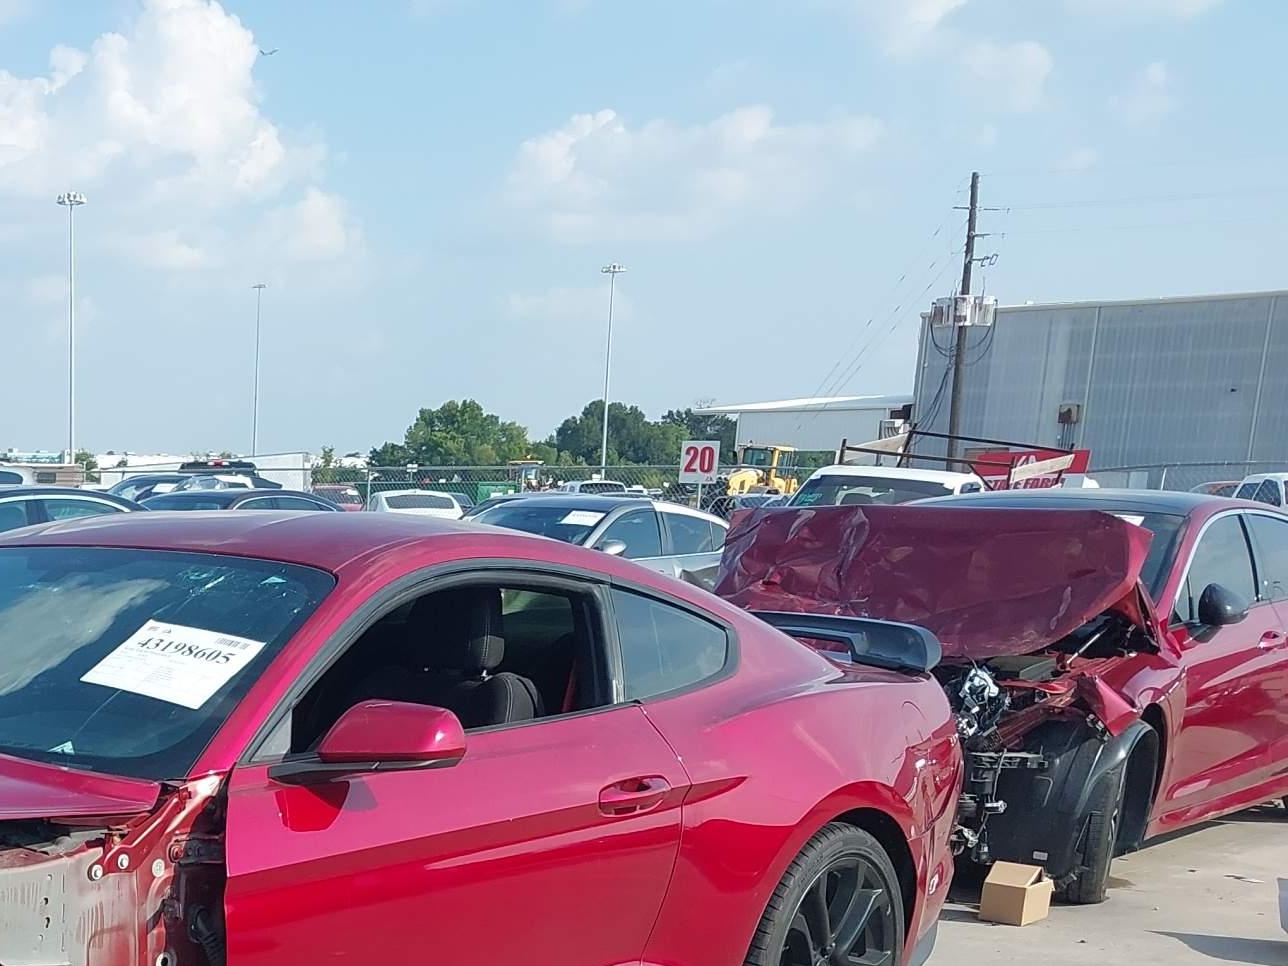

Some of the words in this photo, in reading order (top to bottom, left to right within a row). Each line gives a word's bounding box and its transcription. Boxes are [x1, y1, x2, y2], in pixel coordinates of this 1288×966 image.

[684, 446, 714, 474] 20
[984, 479, 1023, 491] STAE
[138, 637, 237, 664] 43198605
